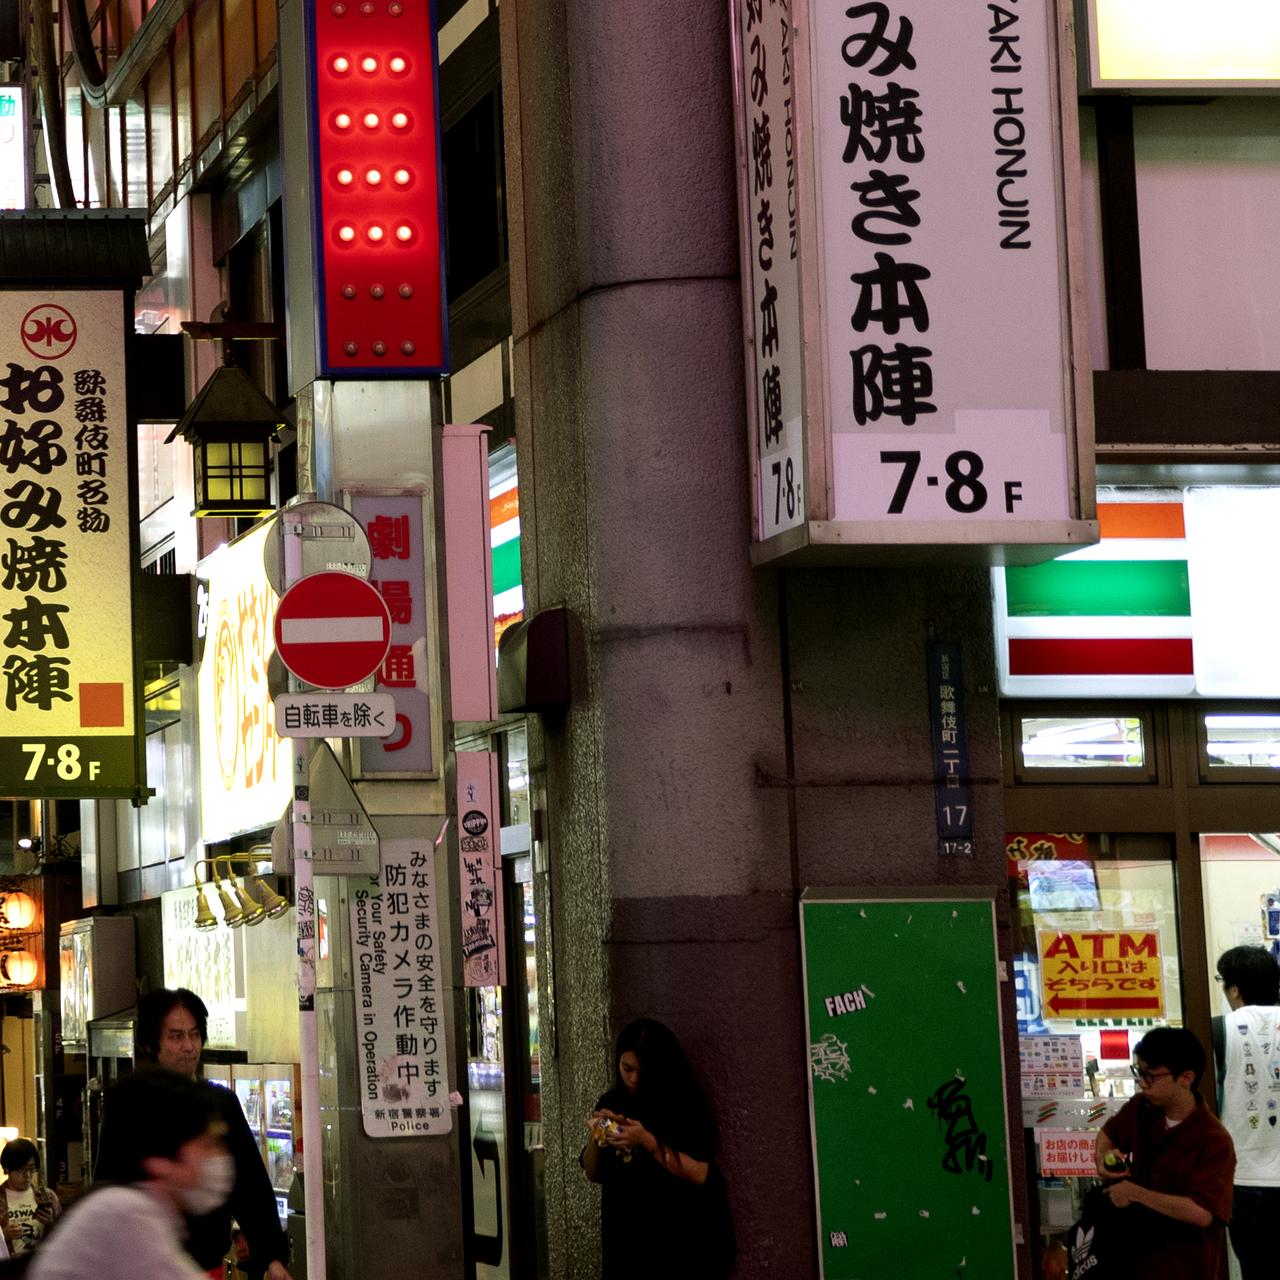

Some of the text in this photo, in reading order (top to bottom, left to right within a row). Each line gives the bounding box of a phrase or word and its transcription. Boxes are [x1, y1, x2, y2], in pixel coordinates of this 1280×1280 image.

[997, 85, 1032, 251] HONJIN
[73, 369, 109, 533] 歌舞伎町名物
[283, 701, 386, 731] 自転車を除く
[942, 806, 968, 827] 17
[354, 889, 369, 948] Security
[373, 892, 384, 928] Your
[372, 930, 388, 976] Safety
[1044, 933, 1158, 959] ATM
[1056, 959, 1148, 976] 入り口は
[358, 953, 373, 1010] Camera
[384, 863, 421, 1086] 防犯カメラ作動中
[409, 850, 442, 1098] みなさまの安全を守ります
[1045, 977, 1160, 992] そちらです
[362, 1029, 379, 1101] Operation
[390, 1119, 431, 1132] Police
